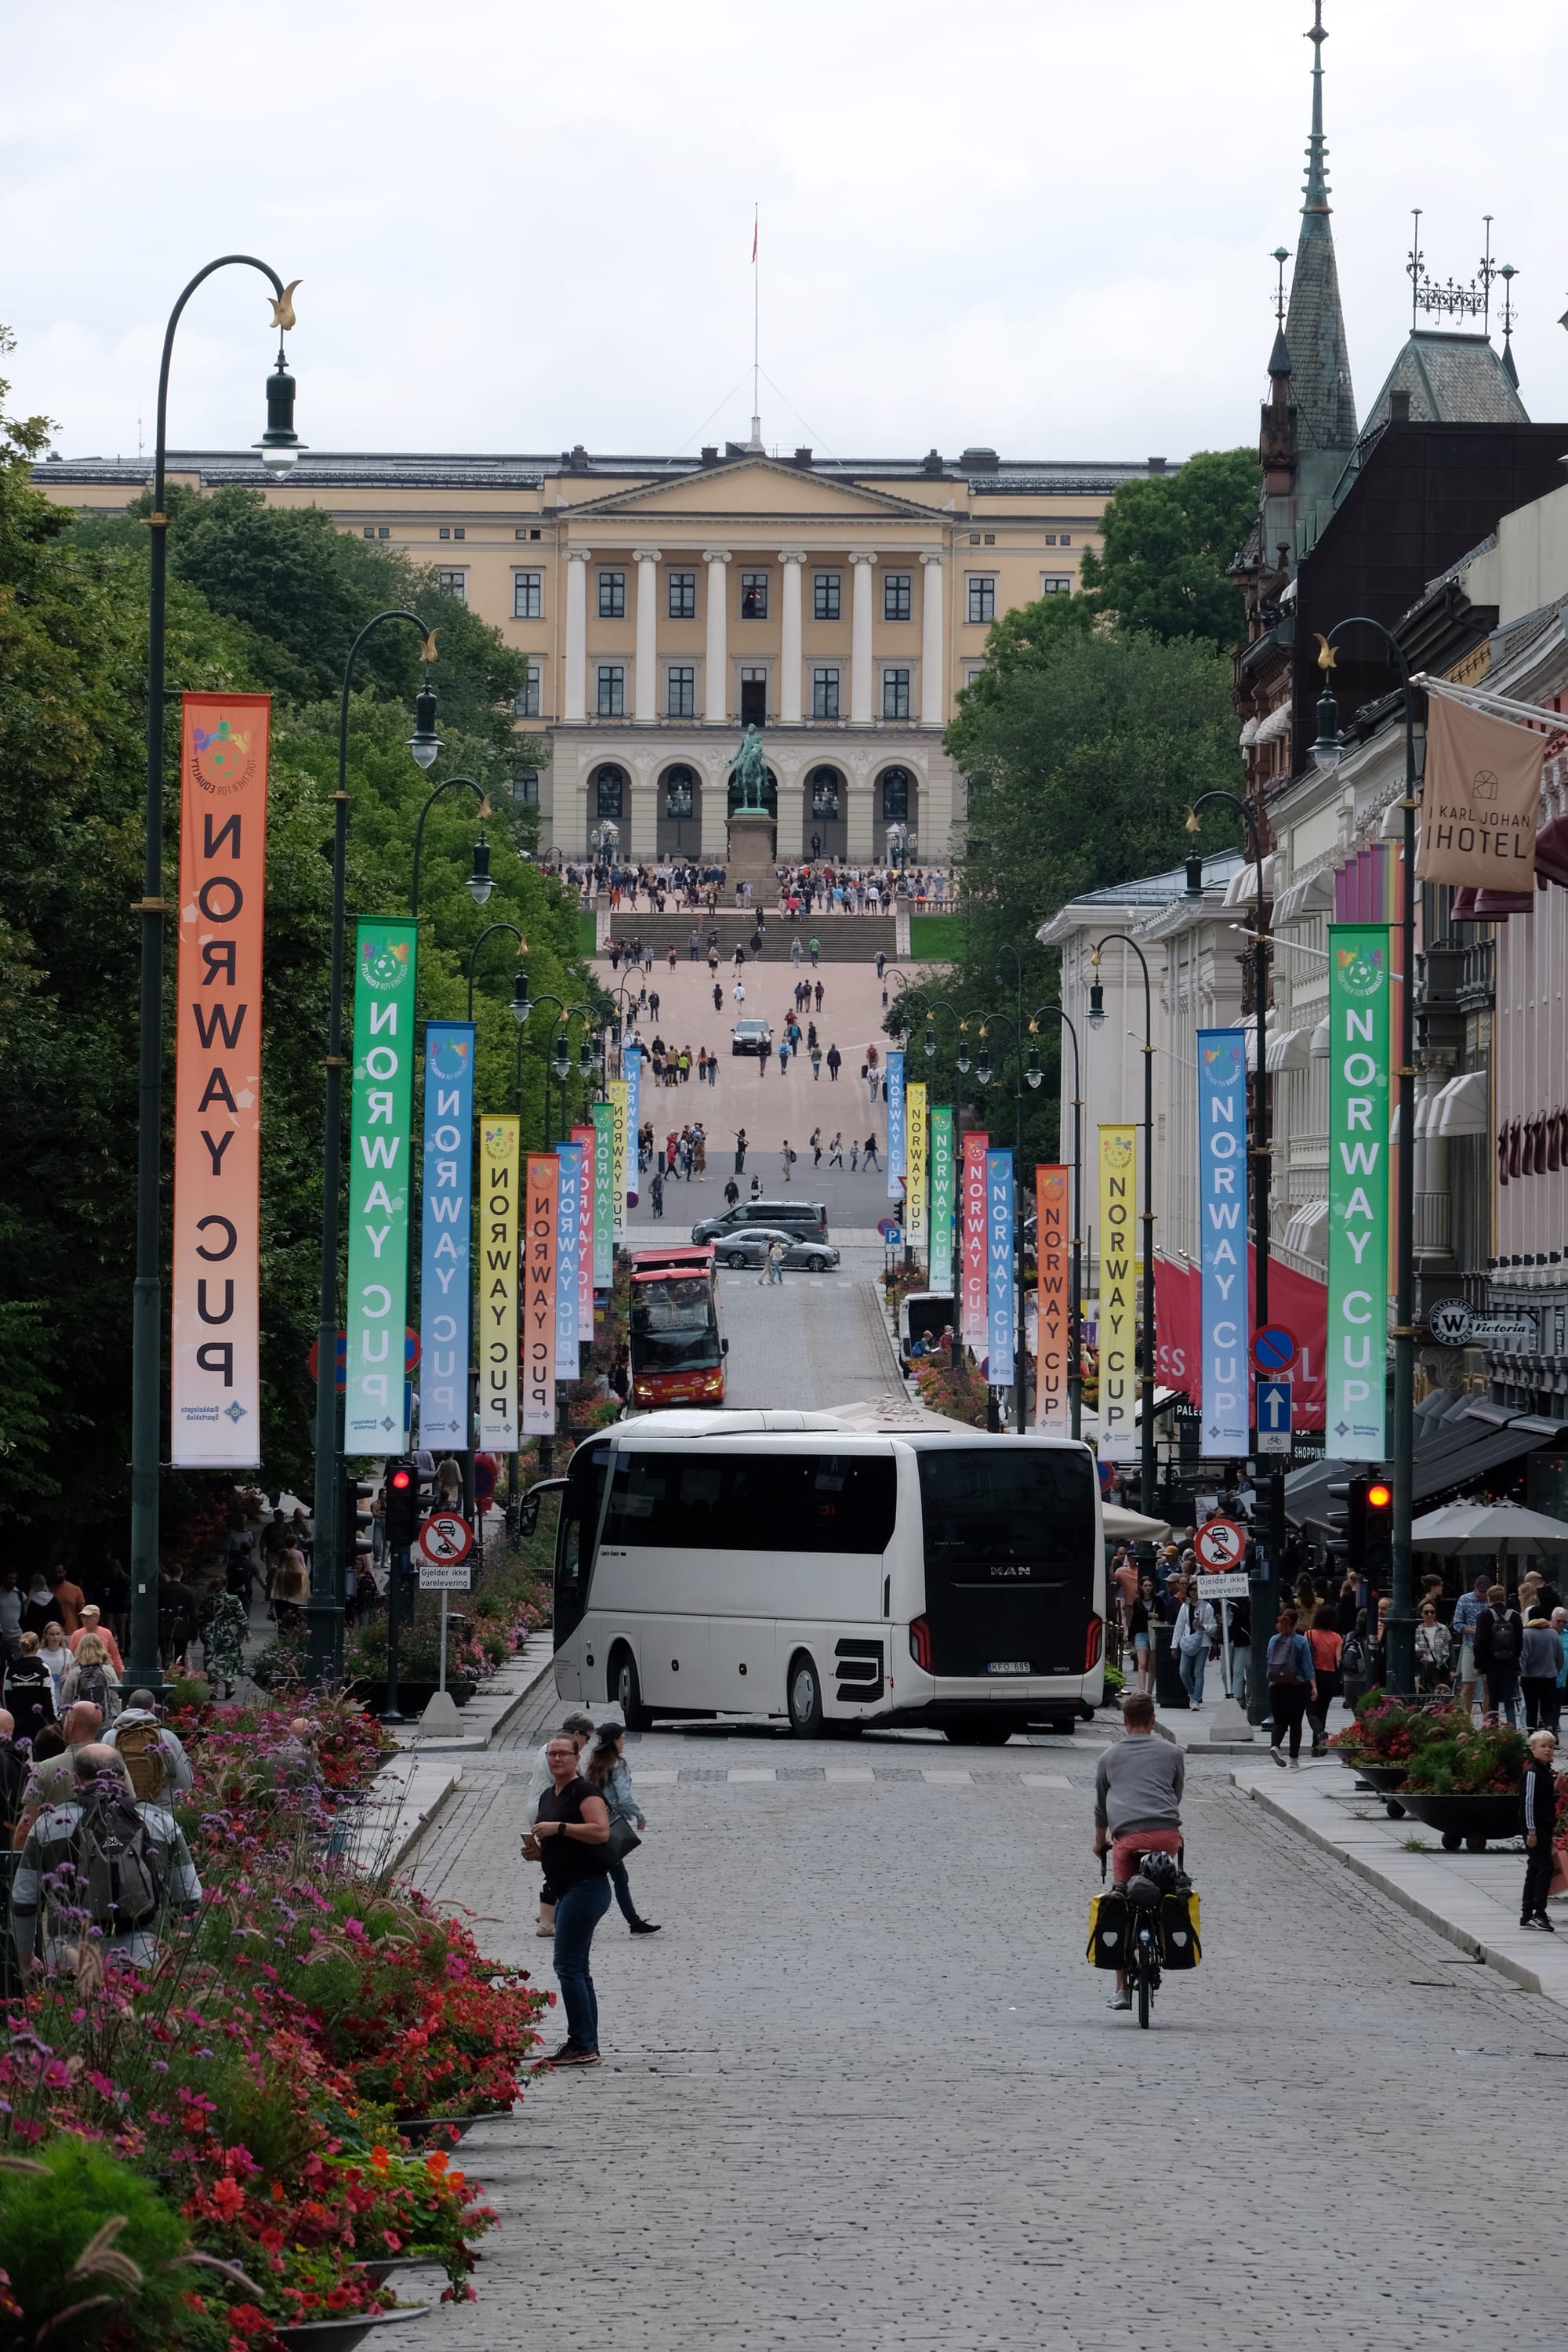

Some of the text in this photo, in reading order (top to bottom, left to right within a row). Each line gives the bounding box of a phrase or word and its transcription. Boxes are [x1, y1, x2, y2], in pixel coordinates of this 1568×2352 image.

[1439, 805, 1530, 828] KARL JOHAN
[1436, 824, 1527, 859] HOTEL
[1364, 971, 1384, 996] EQUALITY
[890, 1074, 902, 1144] NORWAY
[910, 1109, 922, 1186] NORWAY
[1339, 1009, 1380, 1265] NORWAY
[935, 1134, 949, 1222] NORWAY
[1208, 1096, 1240, 1301] NORWAY
[911, 1194, 920, 1231] CUP
[968, 1166, 985, 1268] NORWAY
[888, 1230, 898, 1243] P
[935, 1230, 947, 1272] CUP
[991, 1186, 1010, 1299] NORWAY
[1105, 1177, 1129, 1334] NORWAY
[1043, 1208, 1063, 1339] NORWAY
[969, 1277, 982, 1327] CUP
[1441, 1314, 1465, 1332] W
[993, 1310, 1009, 1364] CUP
[1341, 1290, 1373, 1412] CUP
[1475, 1323, 1526, 1333] Victoria
[1044, 1352, 1060, 1414] CUP
[1108, 1351, 1125, 1427] CUP
[1213, 1321, 1237, 1418] CUP
[1294, 1446, 1326, 1460] SHOPPING
[420, 1579, 468, 1588] varelevering
[421, 1569, 449, 1577] Gjelder
[990, 1566, 1031, 1576] MAN
[1199, 1577, 1227, 1586] Gjelder
[1200, 1586, 1247, 1595] varelevering
[1014, 1662, 1029, 1671] 685
